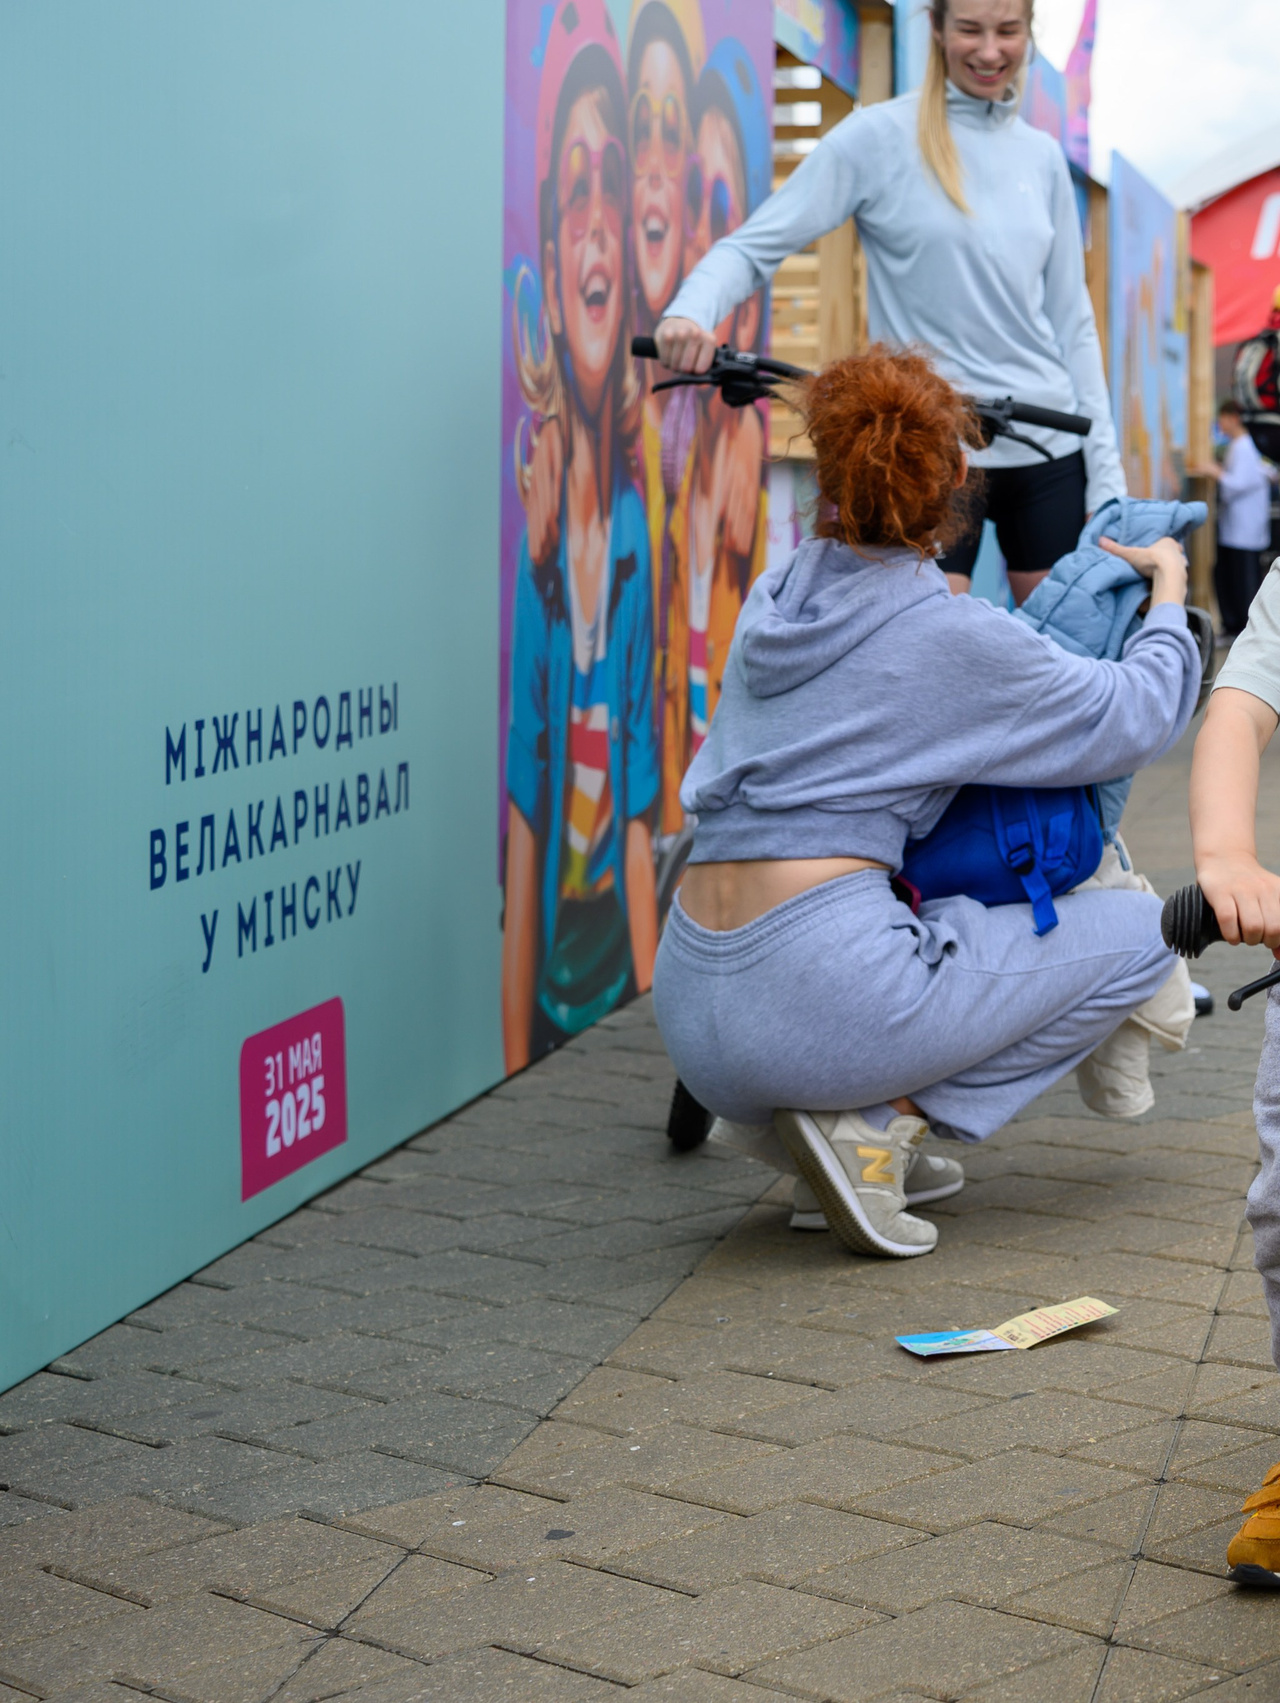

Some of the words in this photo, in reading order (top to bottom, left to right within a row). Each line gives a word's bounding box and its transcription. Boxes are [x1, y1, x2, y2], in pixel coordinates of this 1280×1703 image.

[164, 682, 399, 785] МІЖНАРОДНЫ
[149, 762, 410, 891] ВЕЛАКАРНАВАЛ
[200, 908, 219, 974] У
[237, 860, 362, 959] МІНСКУ
[264, 1051, 284, 1097] 31
[288, 1032, 323, 1085] МАЯ
[265, 1074, 326, 1158] 2025
[856, 1145, 896, 1185] N
